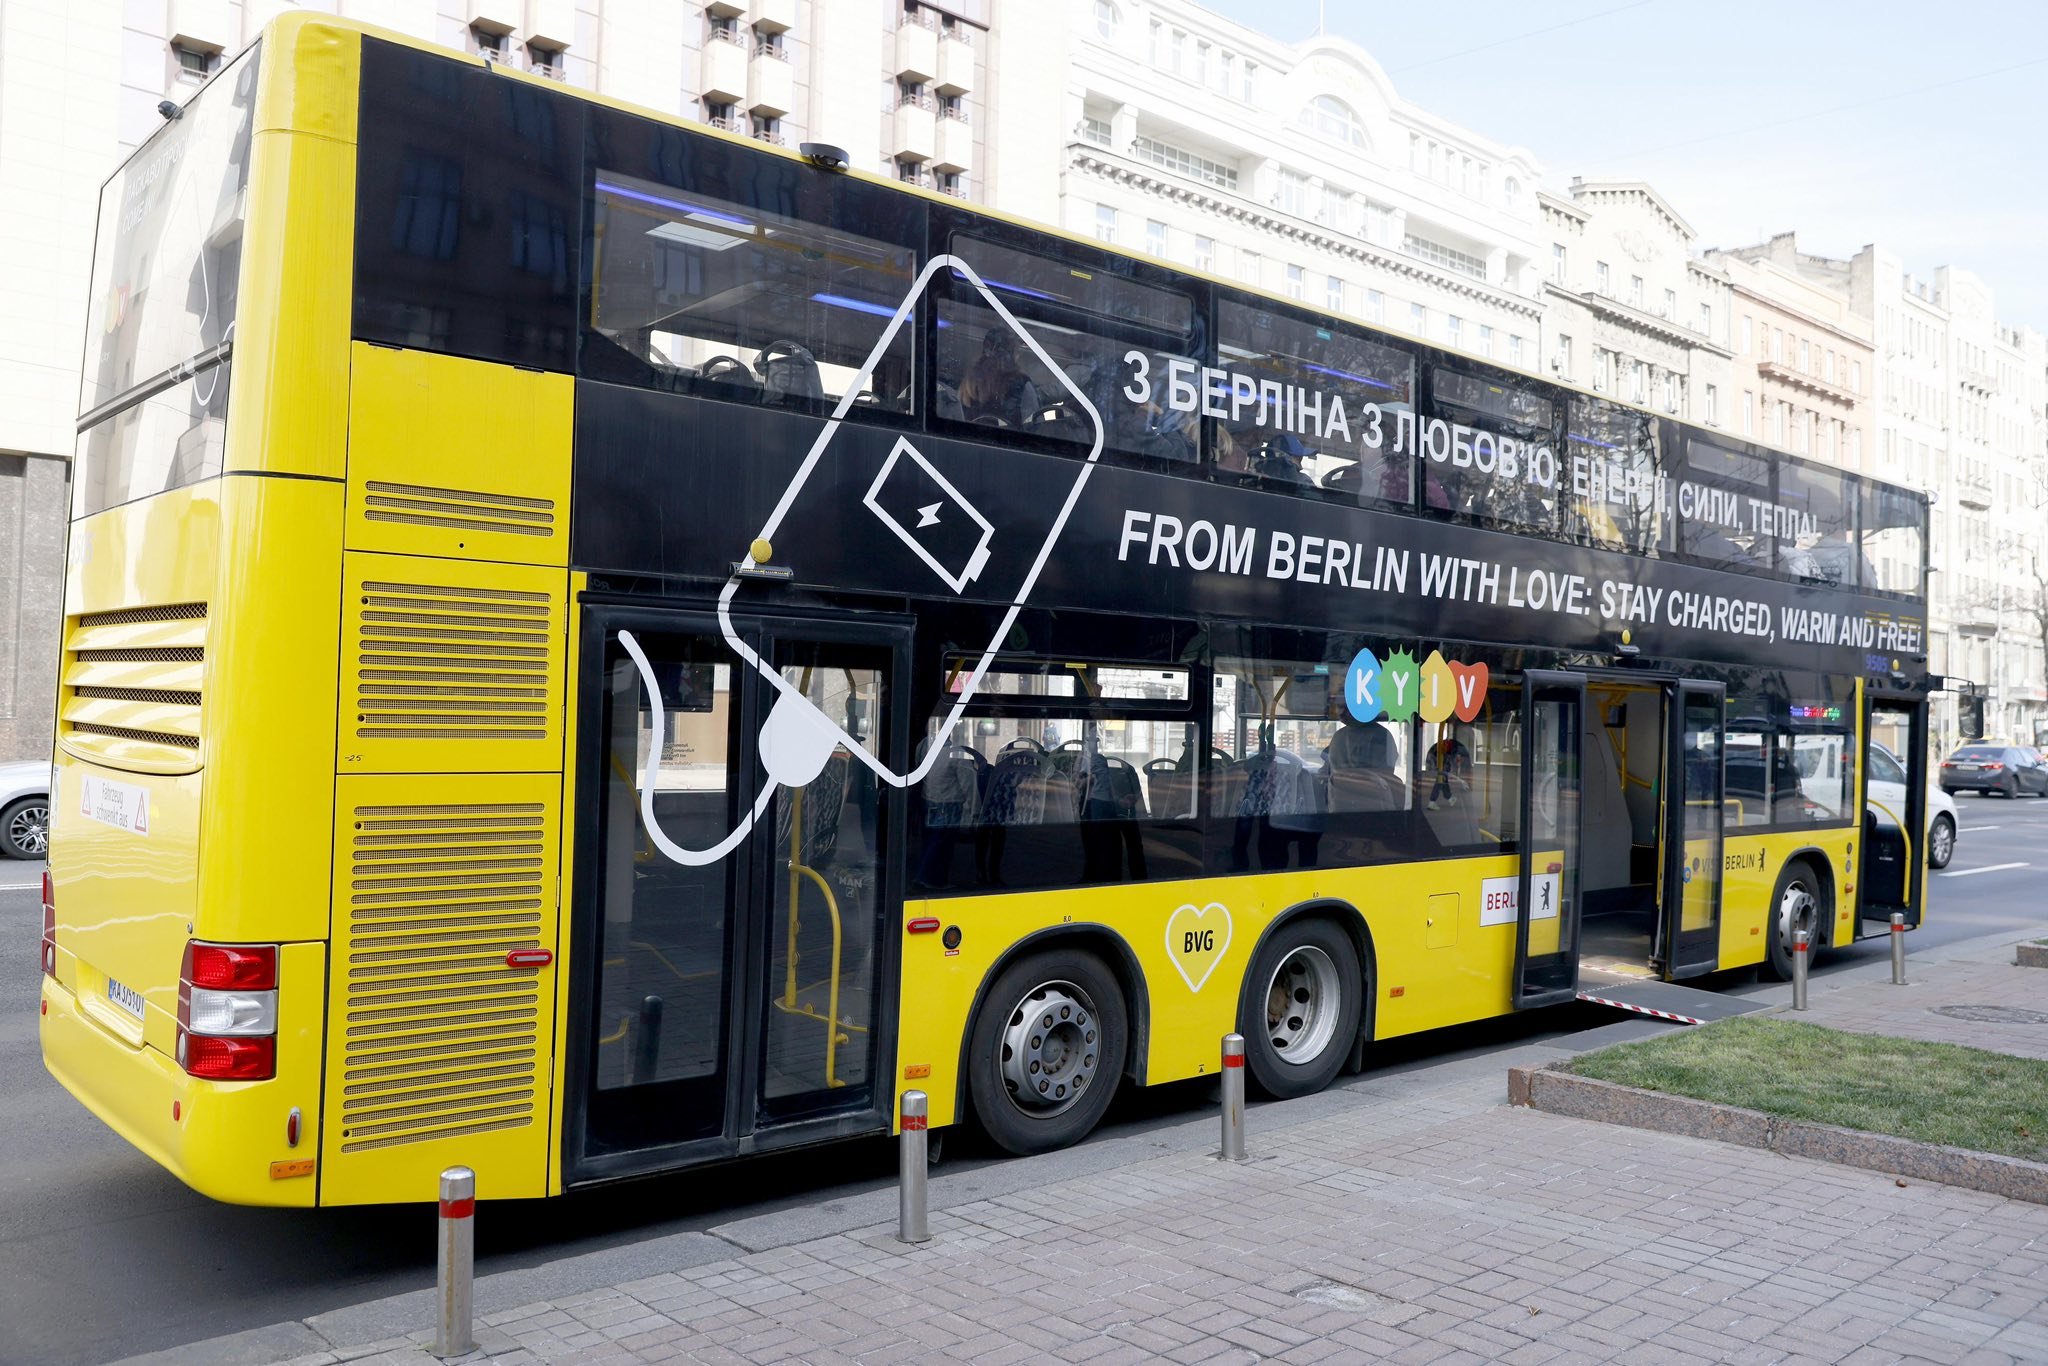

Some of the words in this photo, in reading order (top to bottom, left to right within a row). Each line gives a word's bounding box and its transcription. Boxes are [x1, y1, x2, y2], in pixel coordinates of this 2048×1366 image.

[1123, 350, 1152, 404] З
[1168, 359, 1352, 443] БЕРЛІНА
[1362, 403, 1384, 449] З
[1679, 481, 1744, 535] СИЛИ,
[1748, 498, 1817, 541] ТЕПЛА!
[1118, 509, 1256, 577] FROM
[1266, 531, 1409, 593] BERLIN
[1420, 552, 1500, 605] WITH
[1507, 566, 1593, 617] LOVE:
[1600, 580, 1664, 624] STAY
[1667, 589, 1775, 644] CHARGED,
[1781, 606, 1837, 645] WARM
[1838, 615, 1874, 648] AND
[1877, 620, 1922, 653] FREE!
[1356, 668, 1476, 709] KYIV
[102, 782, 124, 809] Fahrzeug
[96, 803, 119, 825] schwenkt
[119, 812, 128, 828] aus
[1725, 854, 1755, 871] BERLIN
[839, 876, 863, 889] MAN
[1487, 890, 1521, 911] BERLI
[1184, 929, 1214, 954] BVG
